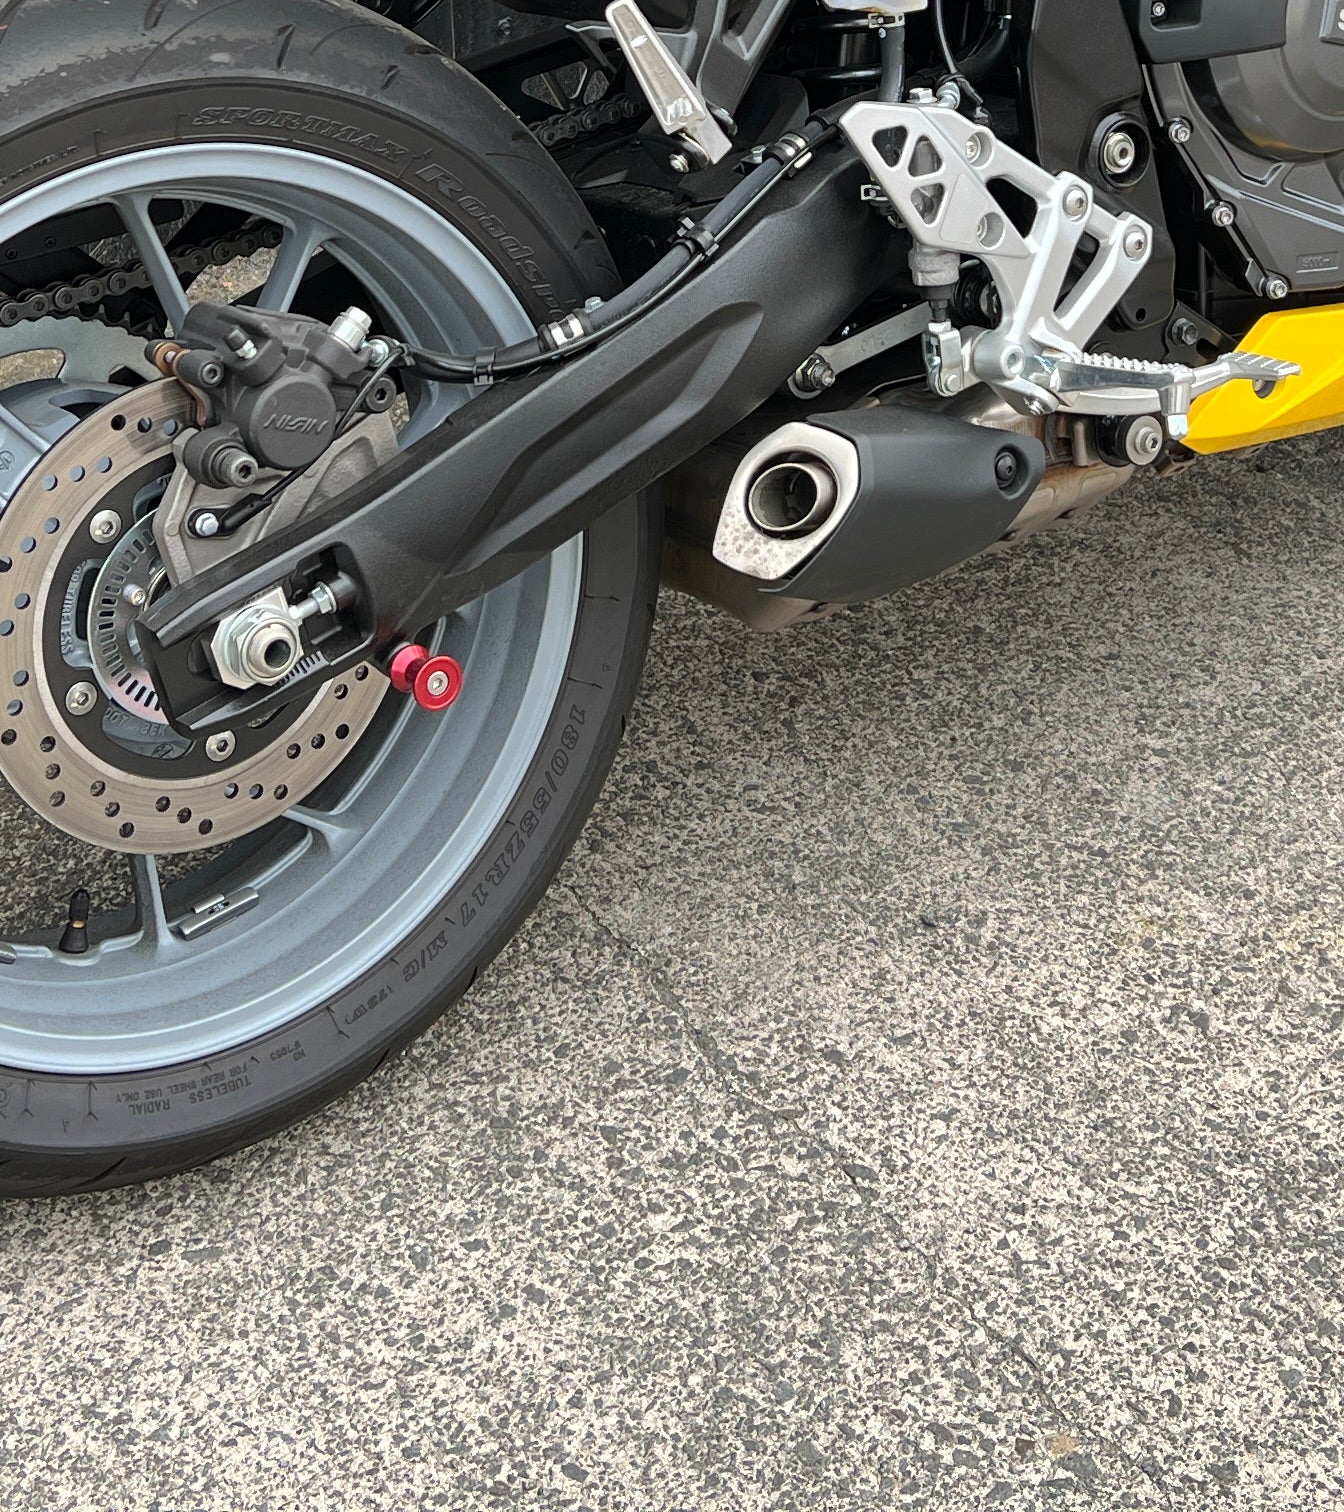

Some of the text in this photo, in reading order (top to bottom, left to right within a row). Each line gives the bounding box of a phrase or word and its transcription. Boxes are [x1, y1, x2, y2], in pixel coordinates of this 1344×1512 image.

[192, 105, 413, 161] SPORTMAX
[128, 1072, 253, 1116] TUBELESS RADIAL
